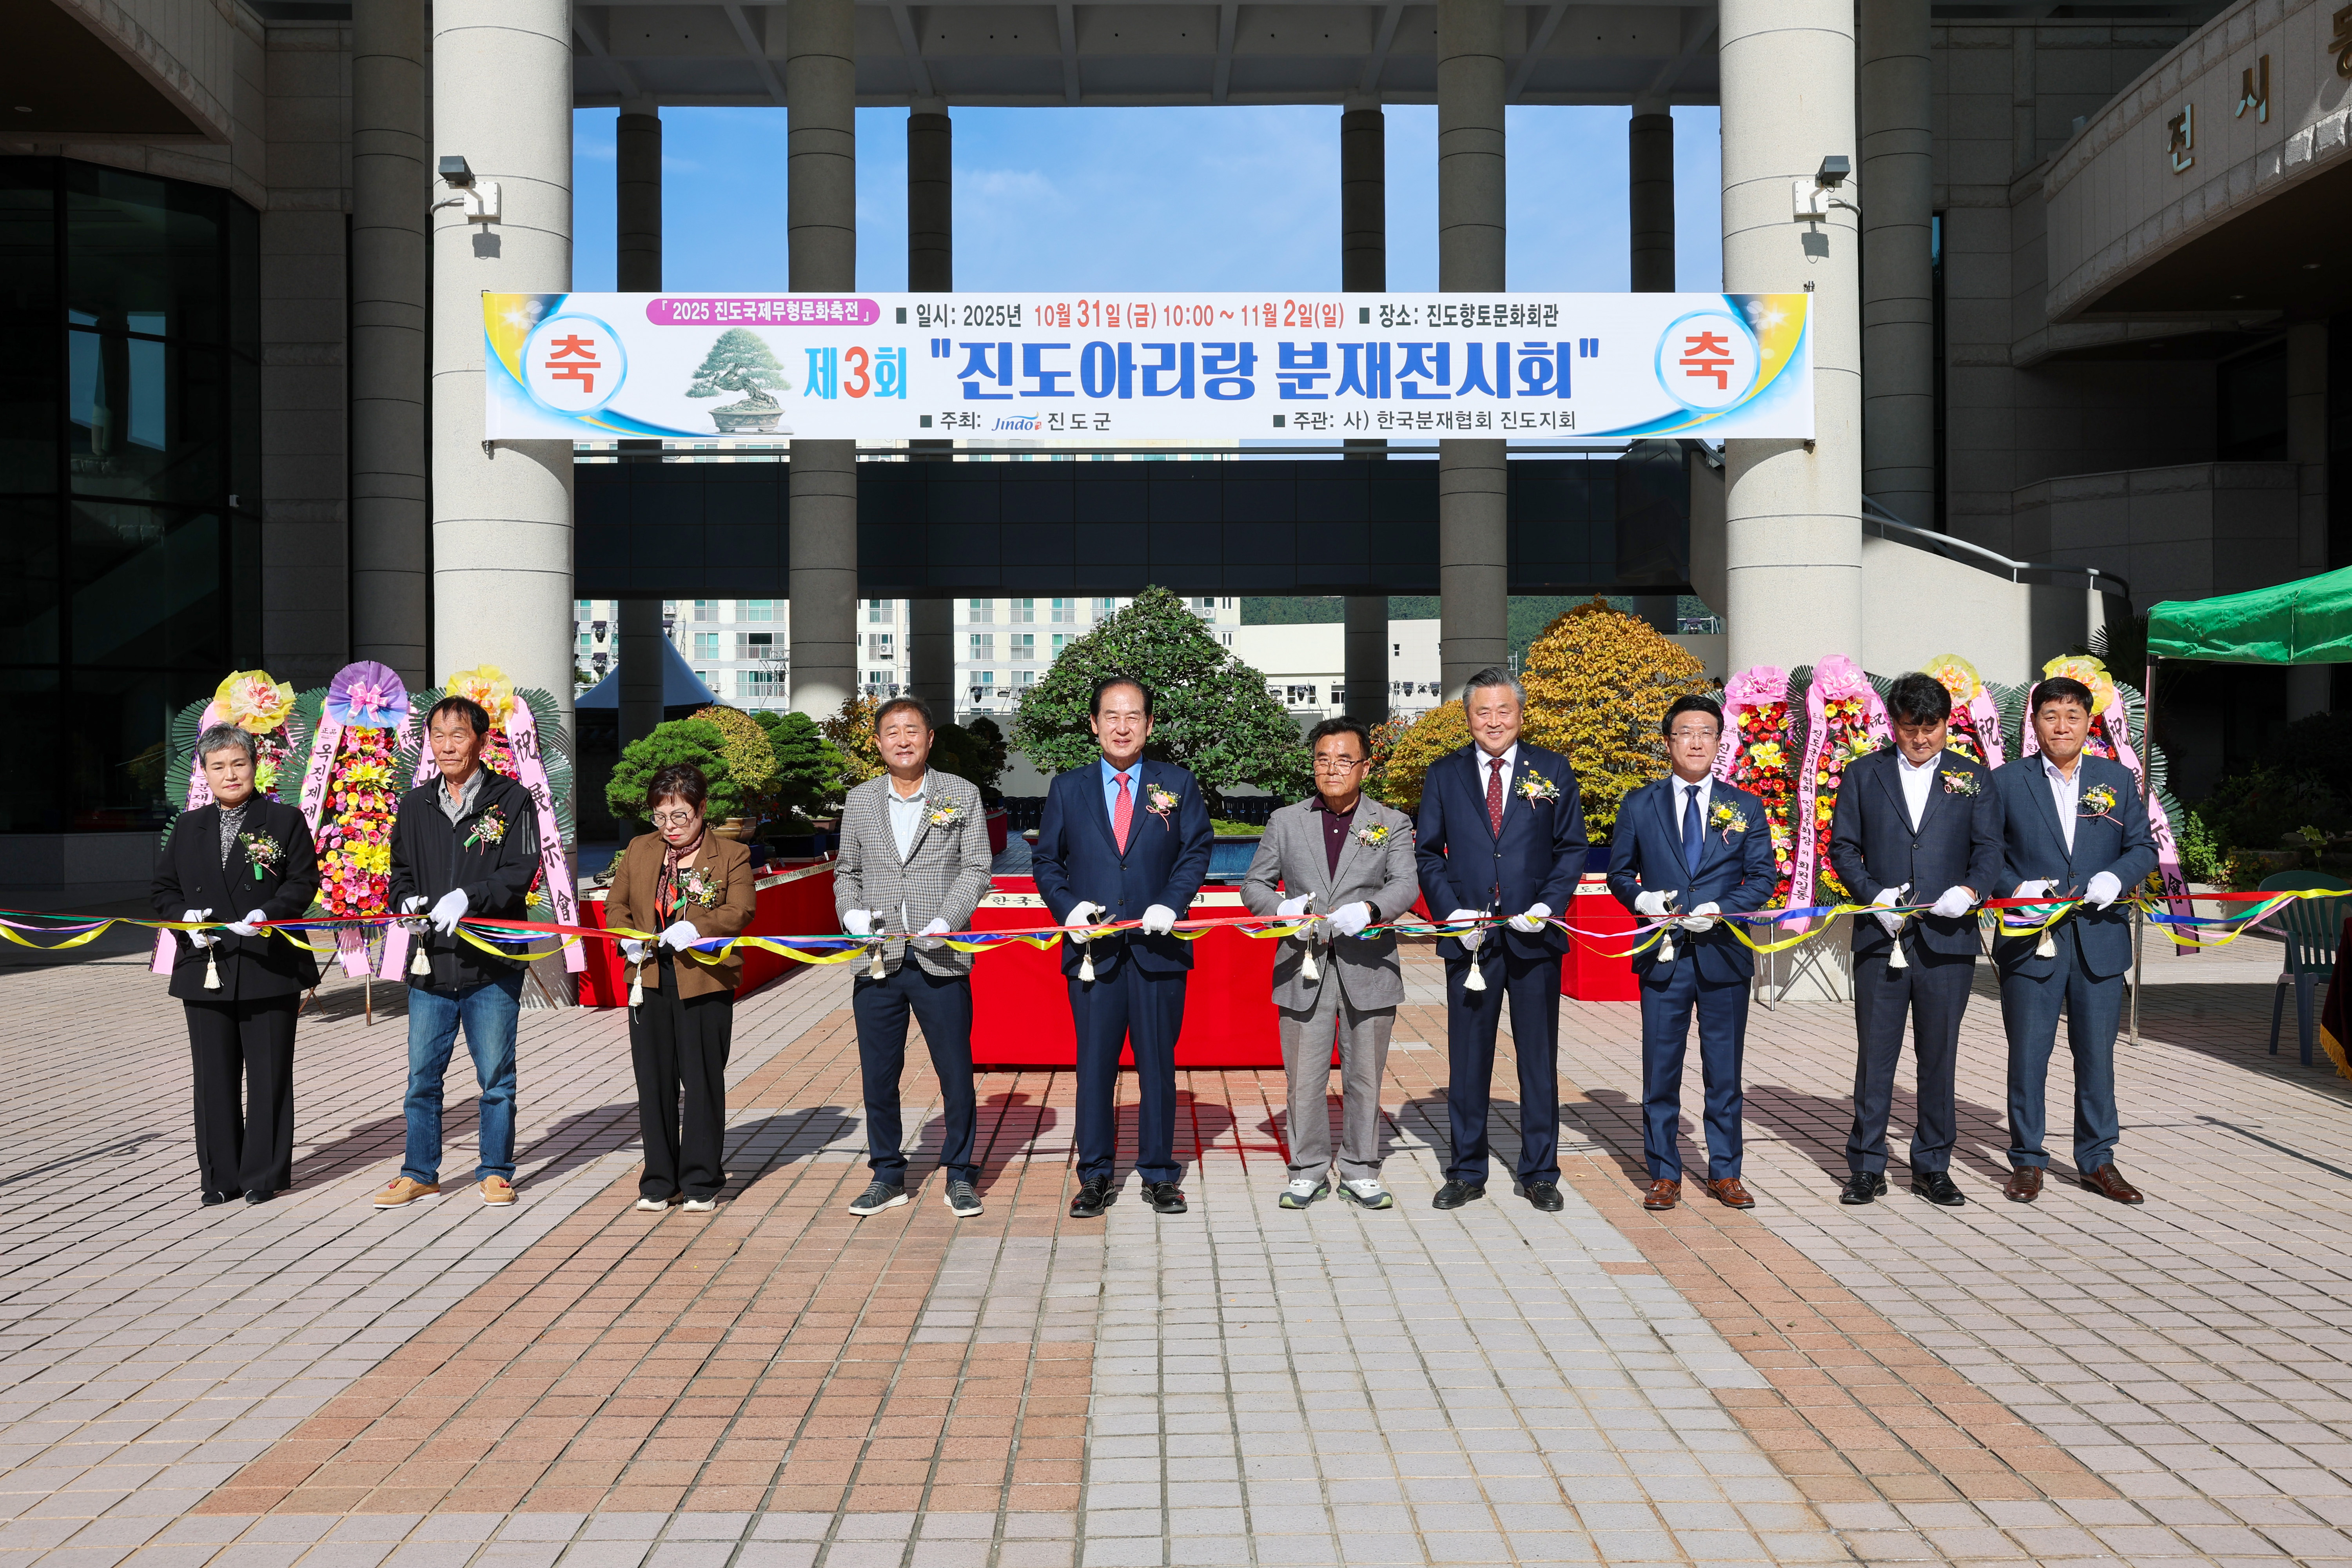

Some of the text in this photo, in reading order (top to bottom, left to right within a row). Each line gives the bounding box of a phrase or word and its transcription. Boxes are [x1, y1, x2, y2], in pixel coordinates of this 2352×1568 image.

[916, 303, 955, 328] 일시:
[964, 303, 1021, 327] 2025년
[1035, 303, 1071, 328] 10월
[1077, 299, 1120, 328] 31일
[1127, 303, 1156, 329] (금)
[1164, 305, 1214, 327] 10:00
[1241, 303, 1277, 327] 11월
[1284, 299, 1344, 329] 2일(일)
[1379, 303, 1559, 328] 장소: 진도향토문화회관
[545, 335, 601, 393] 축
[803, 338, 1599, 401] 제3회 "진도아리랑 분재전시회"
[1679, 332, 1734, 390] 축
[940, 412, 981, 430] 주최:
[991, 418, 1033, 431] Jindo
[1293, 410, 1575, 431] 주관: 사) 한국분재협회 진도지회
[1979, 716, 2000, 749] 祝
[1800, 730, 1822, 794] 진도군기자협회
[303, 744, 332, 832] 옥진제재
[1792, 860, 1809, 900] 회원일동
